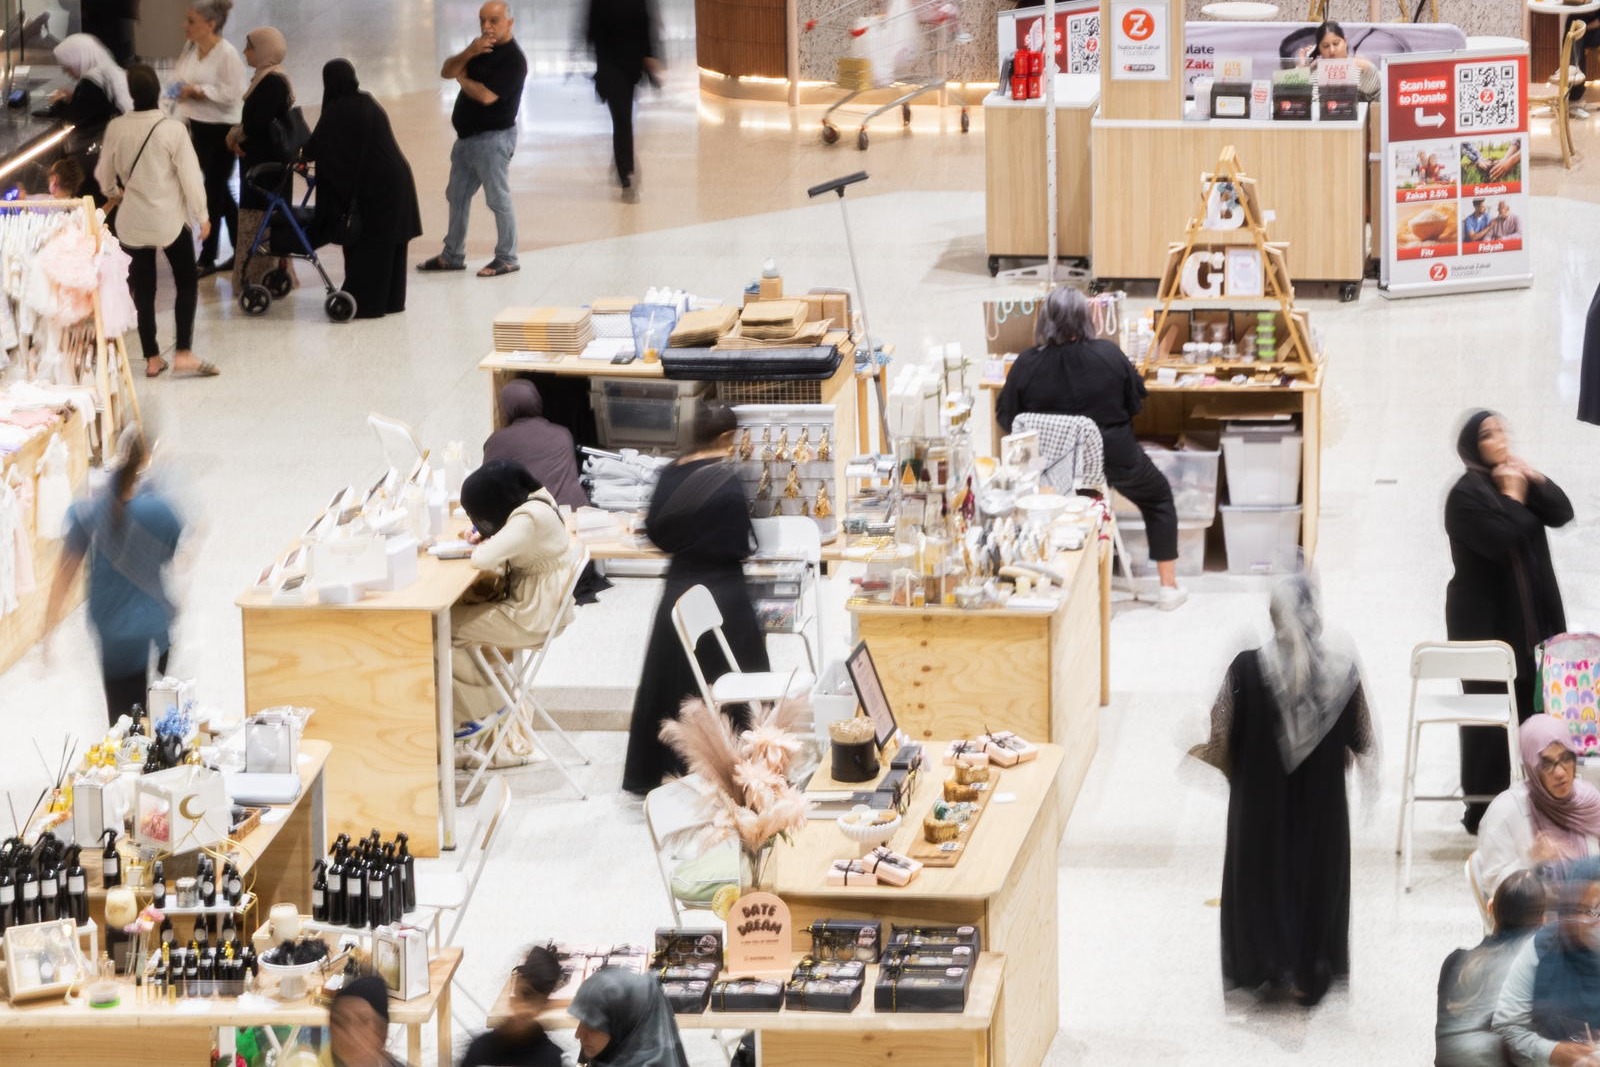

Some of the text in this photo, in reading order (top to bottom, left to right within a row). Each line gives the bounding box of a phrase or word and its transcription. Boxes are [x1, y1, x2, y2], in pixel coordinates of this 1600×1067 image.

[1117, 43, 1161, 51] National Zakat
[1324, 64, 1350, 72] ZAKAT
[1284, 72, 1300, 81] GIVE
[1399, 78, 1447, 92] Scan here
[1399, 91, 1448, 106] to Donate
[1405, 188, 1449, 201] Zakat 2.5%
[1473, 184, 1507, 195] Sadaqah
[1420, 247, 1435, 256] Fitr
[1478, 242, 1504, 252] Fidyah
[1450, 264, 1475, 272] National
[742, 903, 777, 918] DATE
[737, 919, 783, 937] DREAM
